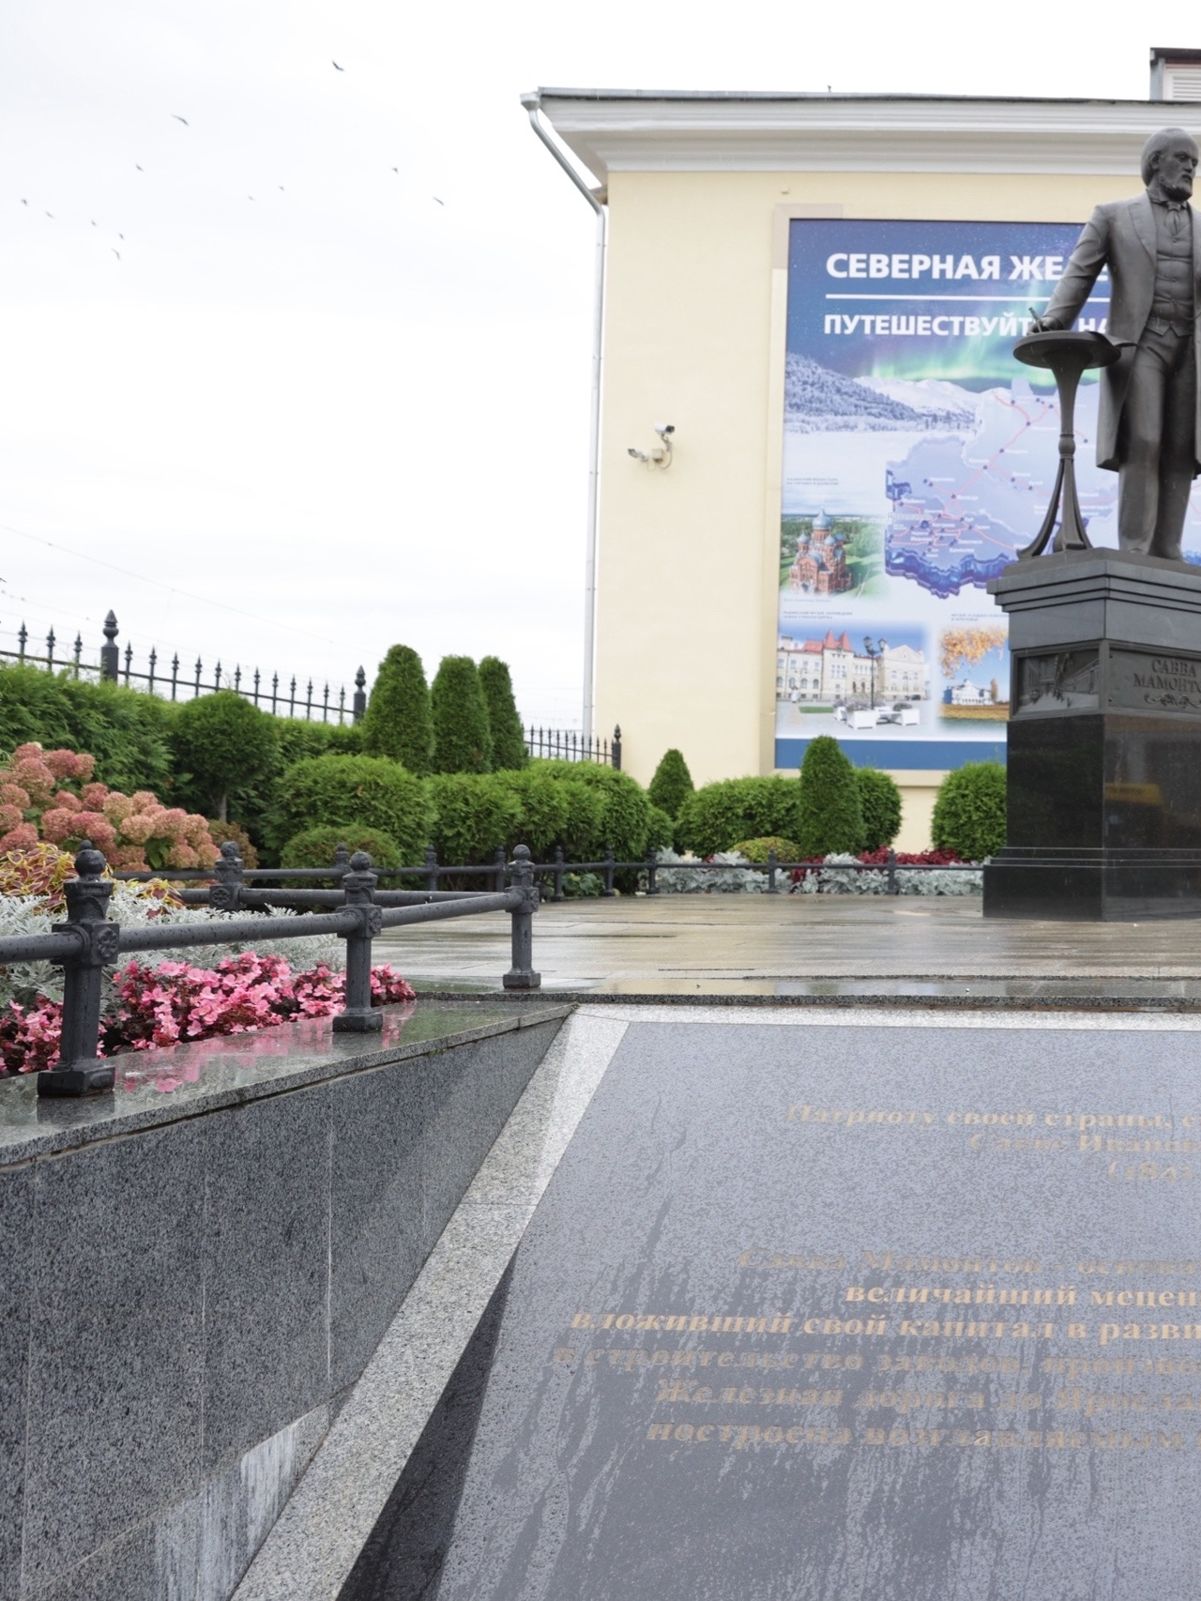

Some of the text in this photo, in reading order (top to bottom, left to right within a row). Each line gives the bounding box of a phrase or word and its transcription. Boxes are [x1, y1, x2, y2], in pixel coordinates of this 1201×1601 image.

[825, 252, 1000, 280] СЕВЕРНАЯ
[823, 311, 1036, 337] ПУТЕШЕСТВУЙТ
[1152, 657, 1197, 678] САВВА
[785, 1103, 935, 1128] Патриоту
[946, 1105, 1037, 1127] своей
[845, 1283, 1077, 1306] величайший
[570, 1311, 792, 1334] вложивший
[803, 1313, 887, 1336] свой
[900, 1319, 1053, 1339] капитал
[1067, 1321, 1086, 1339] в
